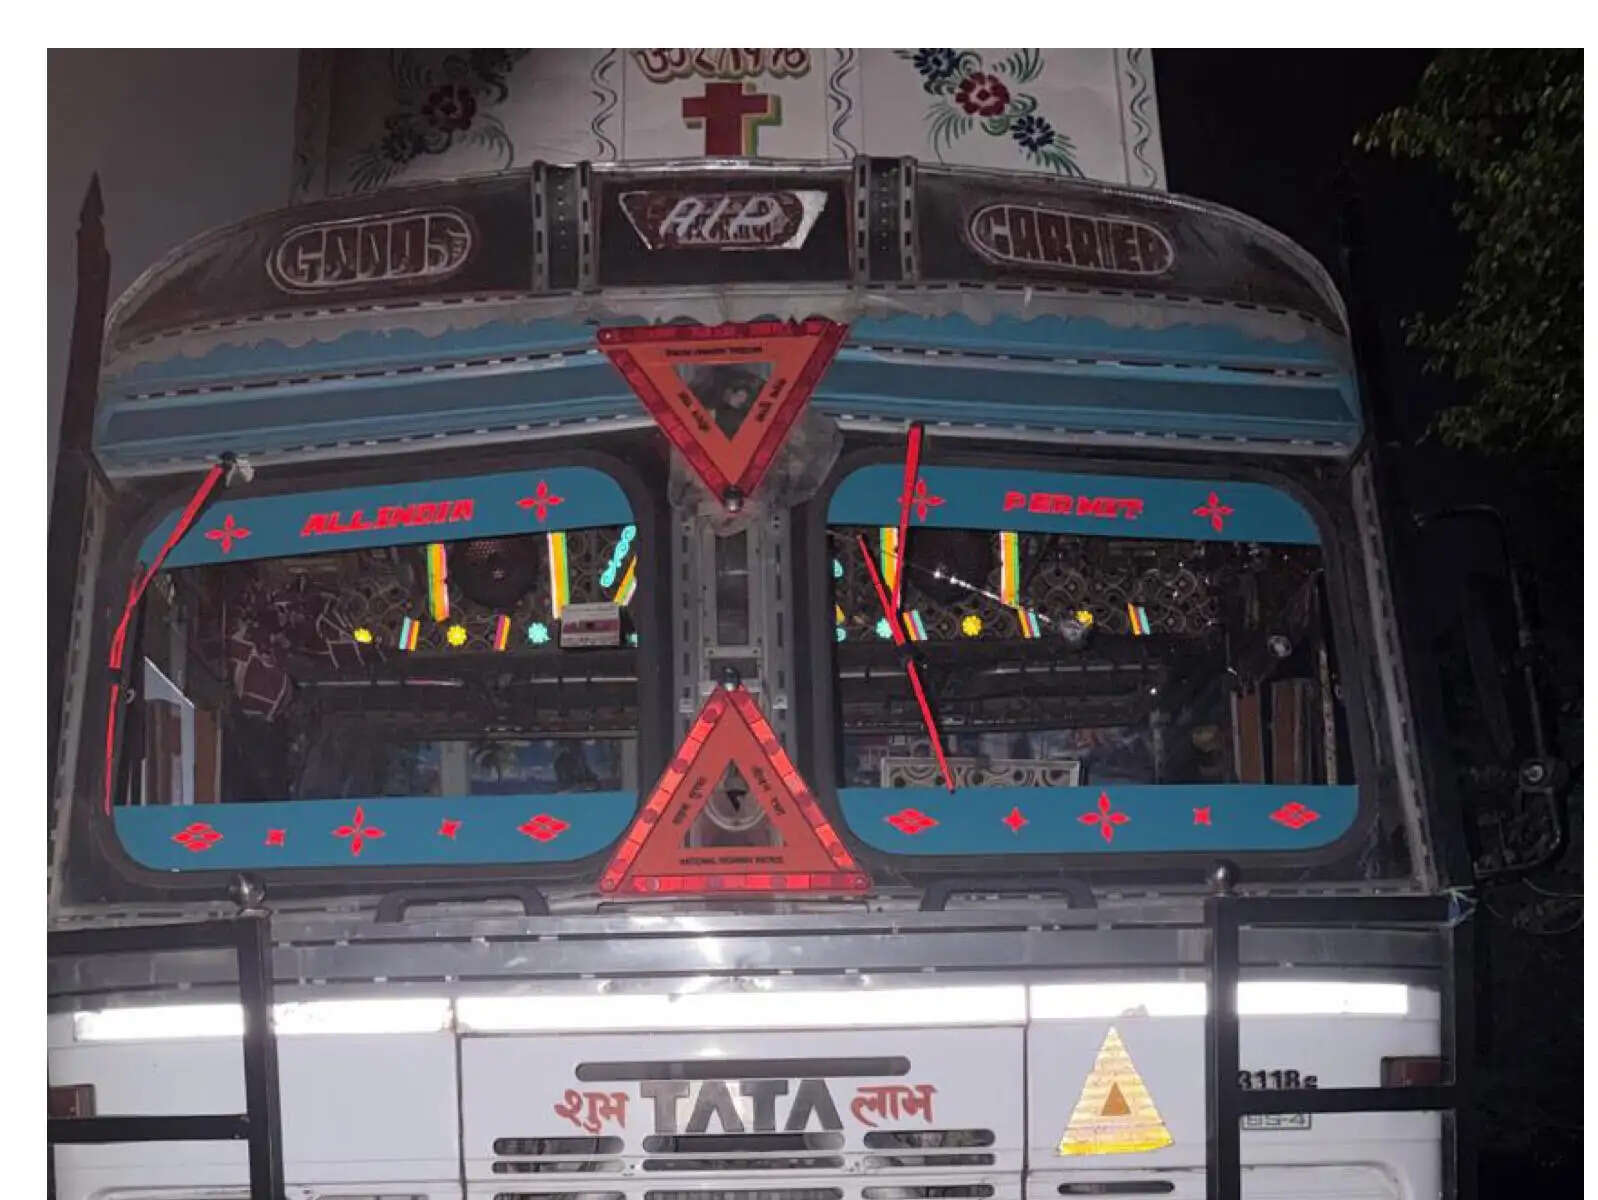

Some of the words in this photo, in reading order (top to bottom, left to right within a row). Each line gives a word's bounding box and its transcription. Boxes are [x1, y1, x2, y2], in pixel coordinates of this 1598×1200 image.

[554, 1088, 630, 1134] शुभ
[640, 1079, 845, 1133] TATA
[850, 1083, 938, 1128] लाभ
